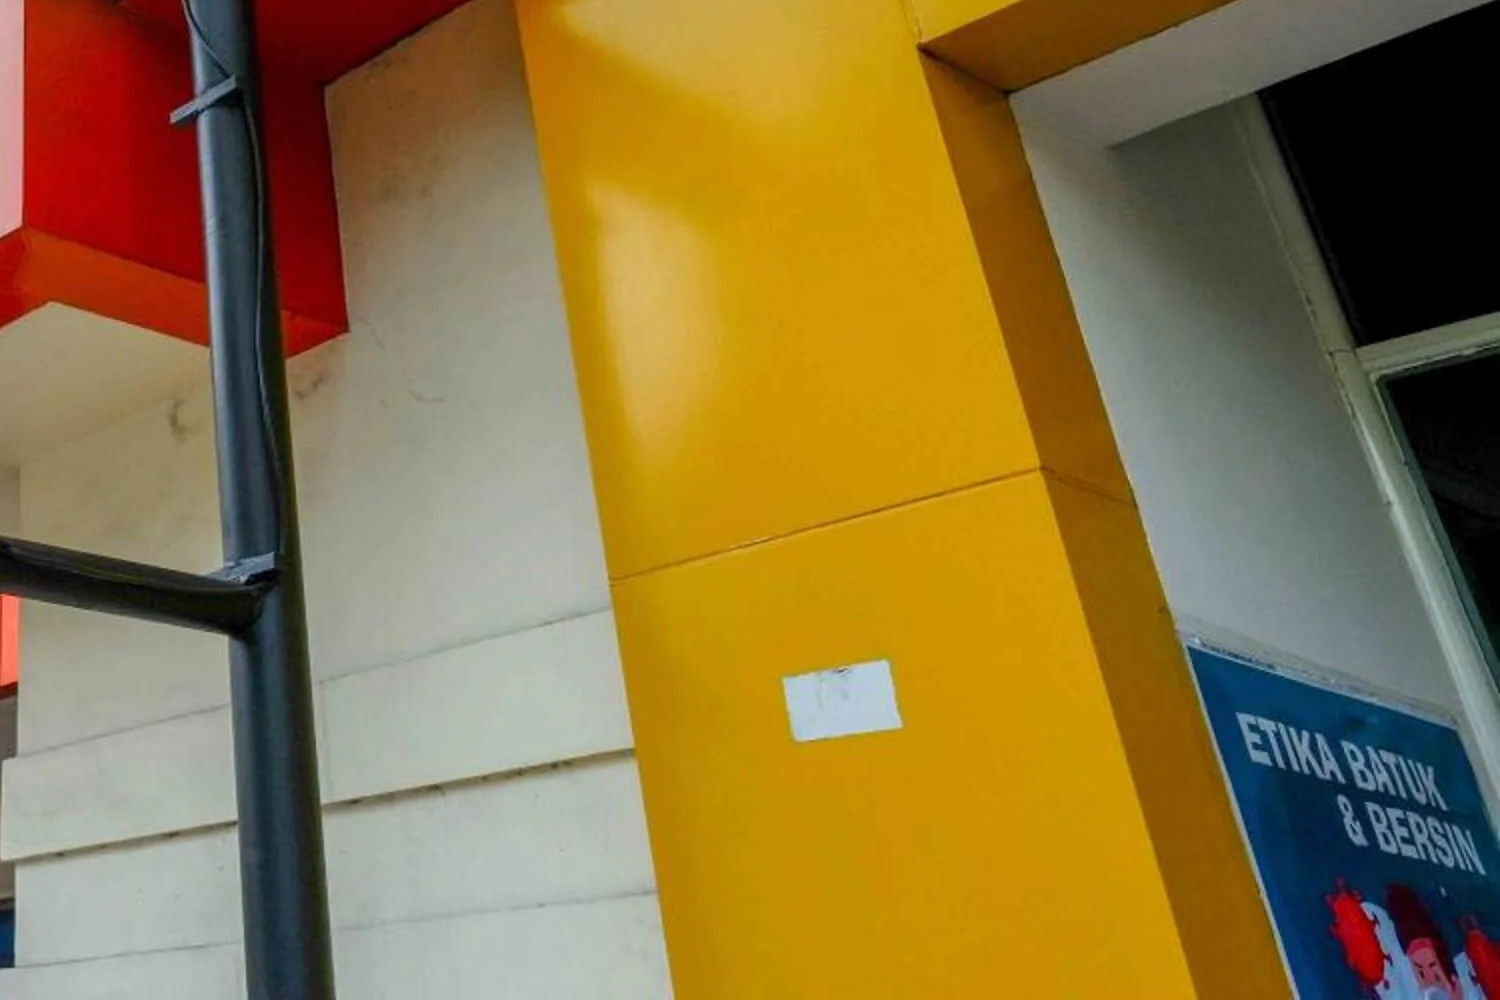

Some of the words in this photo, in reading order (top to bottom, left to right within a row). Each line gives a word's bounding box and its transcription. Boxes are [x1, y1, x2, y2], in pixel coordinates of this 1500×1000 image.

[1236, 711, 1346, 784] ETIKA
[1340, 740, 1449, 812] BATUK
[1336, 794, 1369, 847] &
[1364, 801, 1486, 876] BERSIN
